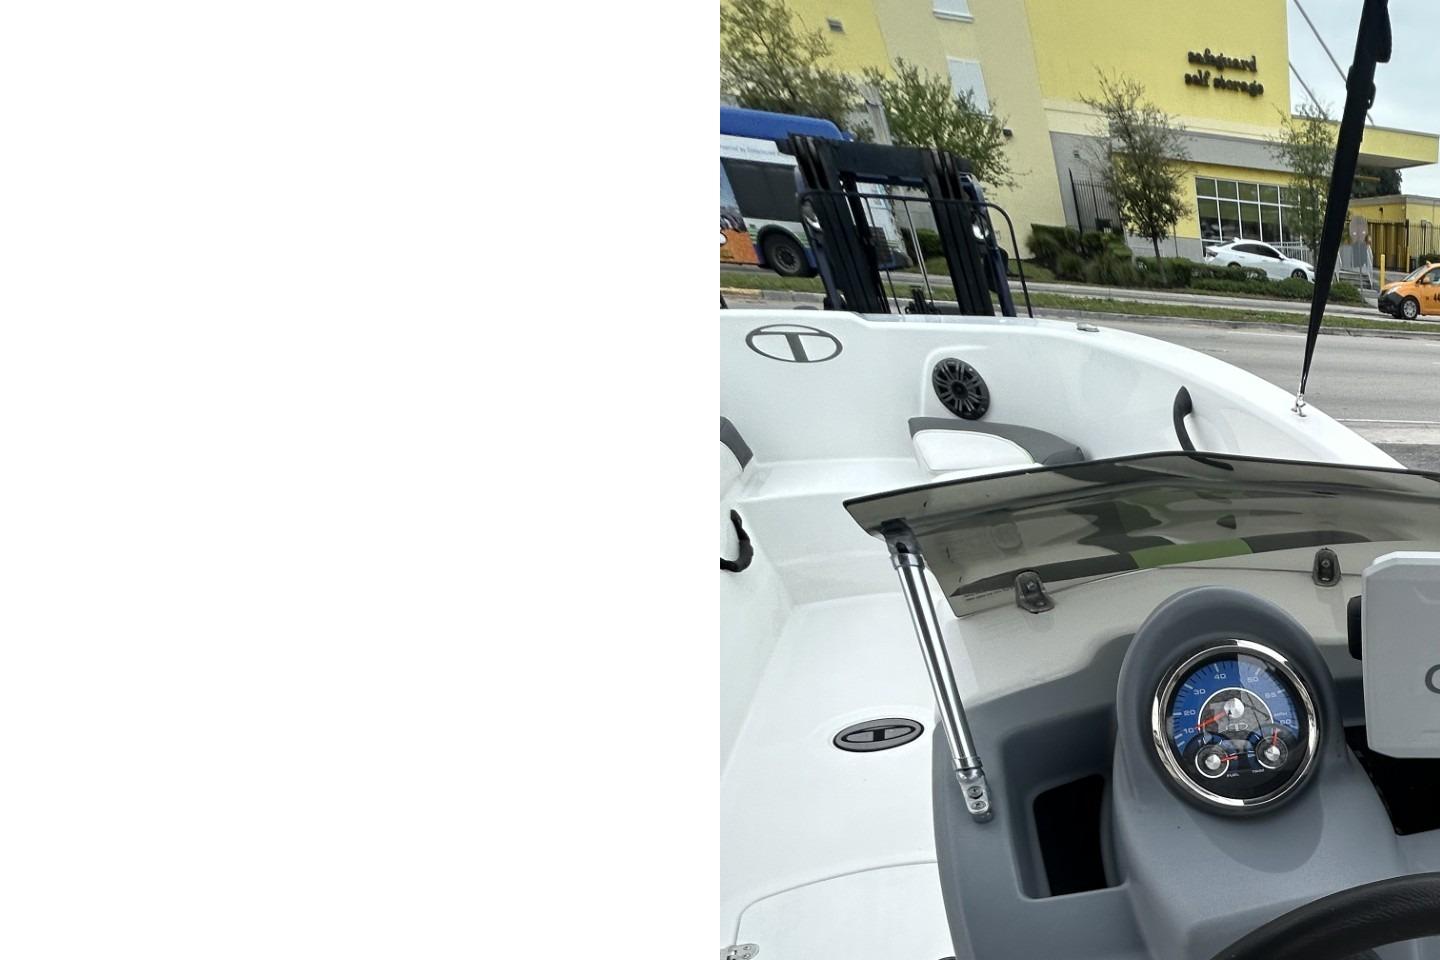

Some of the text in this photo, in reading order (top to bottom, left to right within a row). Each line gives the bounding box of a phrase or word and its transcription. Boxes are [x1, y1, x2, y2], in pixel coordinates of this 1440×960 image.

[1187, 48, 1257, 72] safeguard
[1184, 69, 1264, 97] self storage
